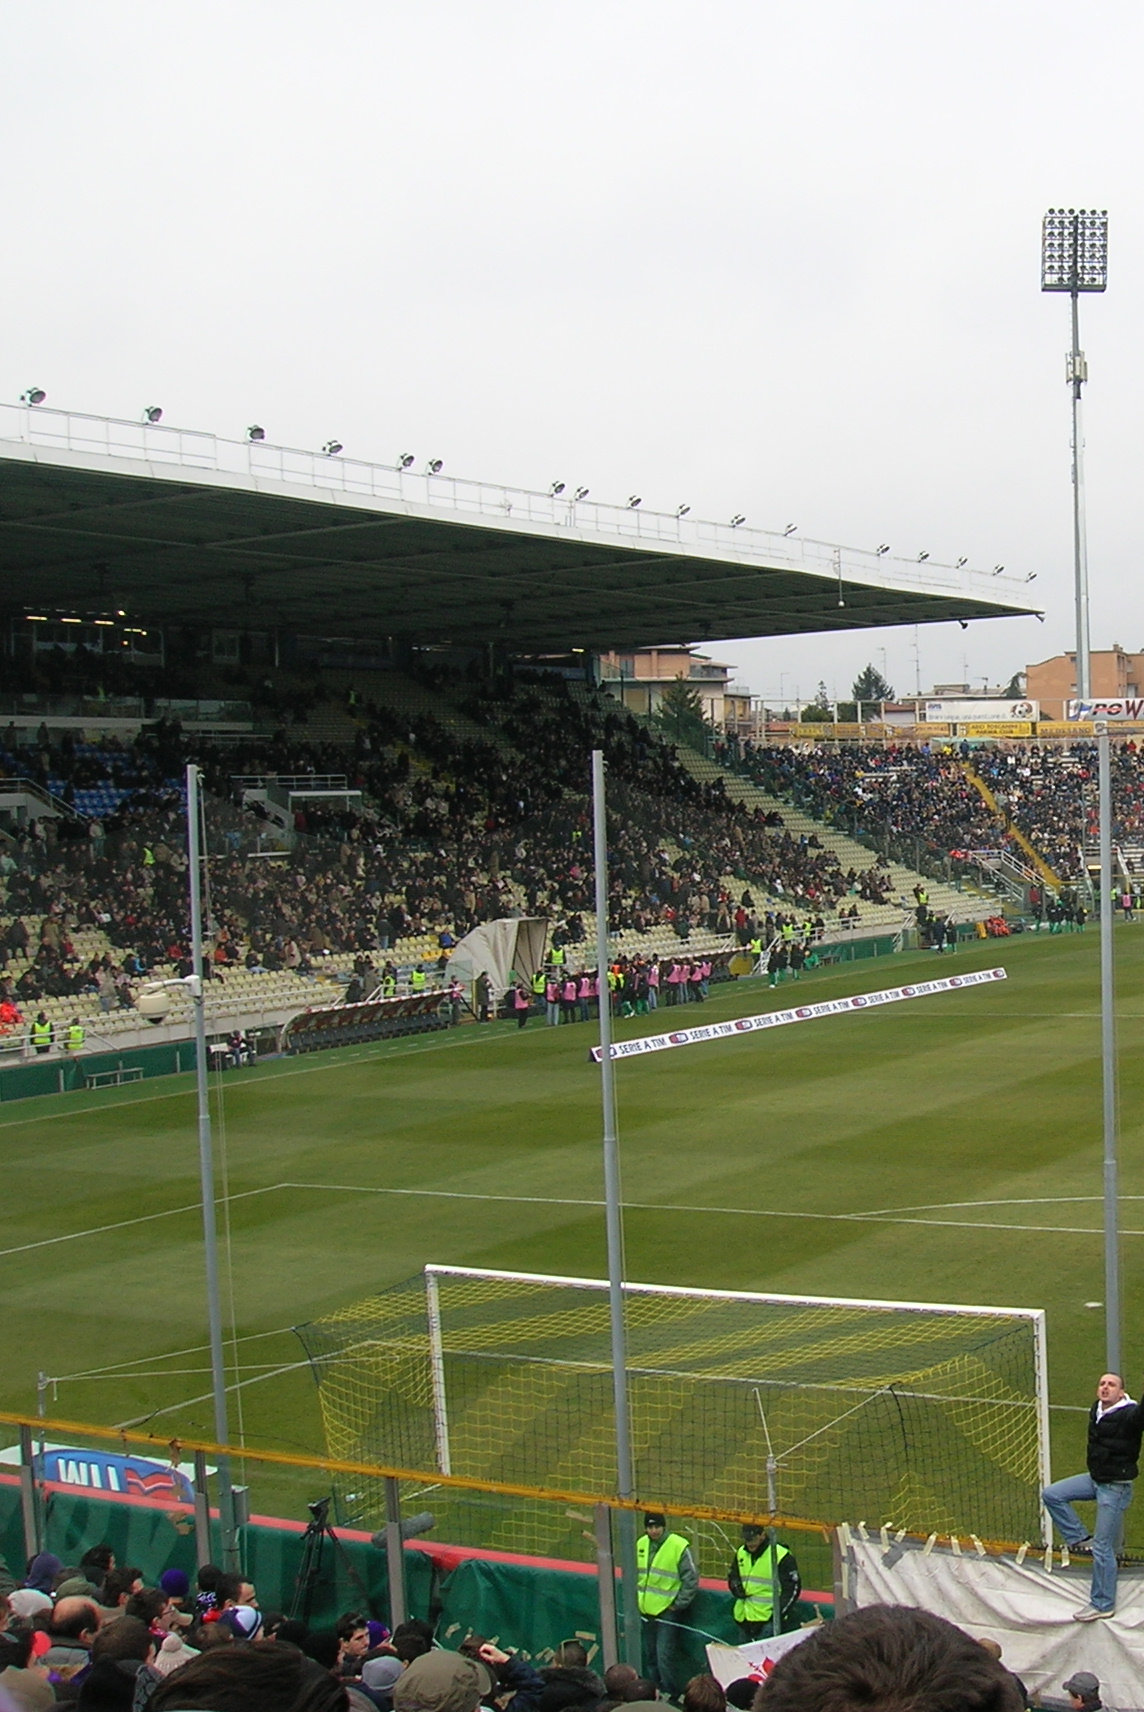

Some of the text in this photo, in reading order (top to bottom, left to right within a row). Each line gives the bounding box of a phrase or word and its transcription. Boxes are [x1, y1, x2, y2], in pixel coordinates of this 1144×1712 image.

[963, 975, 978, 983] SERIE
[916, 985, 932, 993] SERIE
[867, 994, 884, 1004] SERIE
[813, 1006, 831, 1015] SERIE
[754, 1016, 773, 1027] SERIE
[781, 1012, 794, 1021] TIM
[690, 1024, 733, 1040] SERIE A TIM
[619, 1038, 666, 1054] SERIE A TIM
